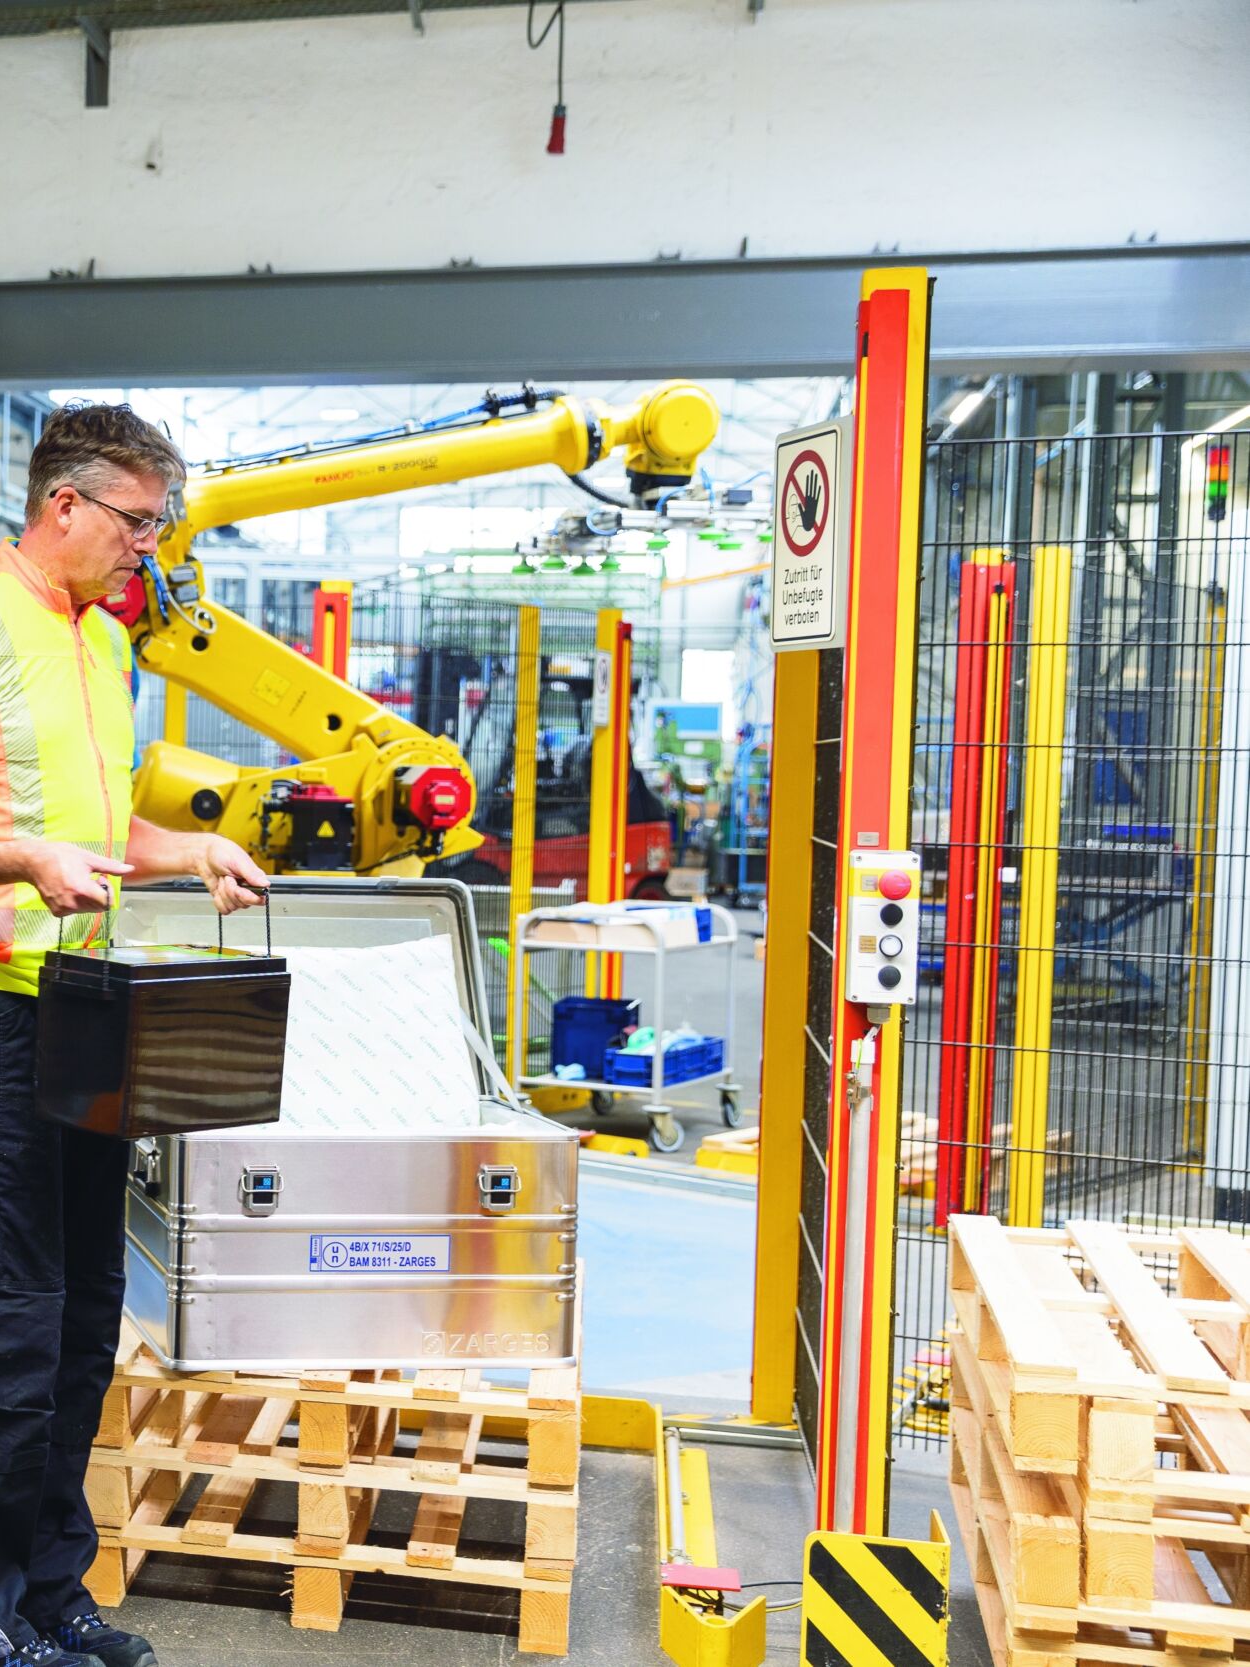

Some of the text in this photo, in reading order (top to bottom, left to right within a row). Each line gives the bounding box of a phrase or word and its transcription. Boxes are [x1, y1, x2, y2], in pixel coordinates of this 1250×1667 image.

[315, 469, 354, 484] FANUC
[784, 565, 822, 585] Zutritt für
[783, 587, 823, 606] Unbefugte
[784, 609, 820, 626] verboten
[350, 1242, 411, 1252] 4B/X 71/S/25/D
[350, 1257, 369, 1267] BAM
[372, 1257, 391, 1267] 8311
[399, 1257, 436, 1267] ZARGES
[450, 1333, 550, 1353] ZARGES
